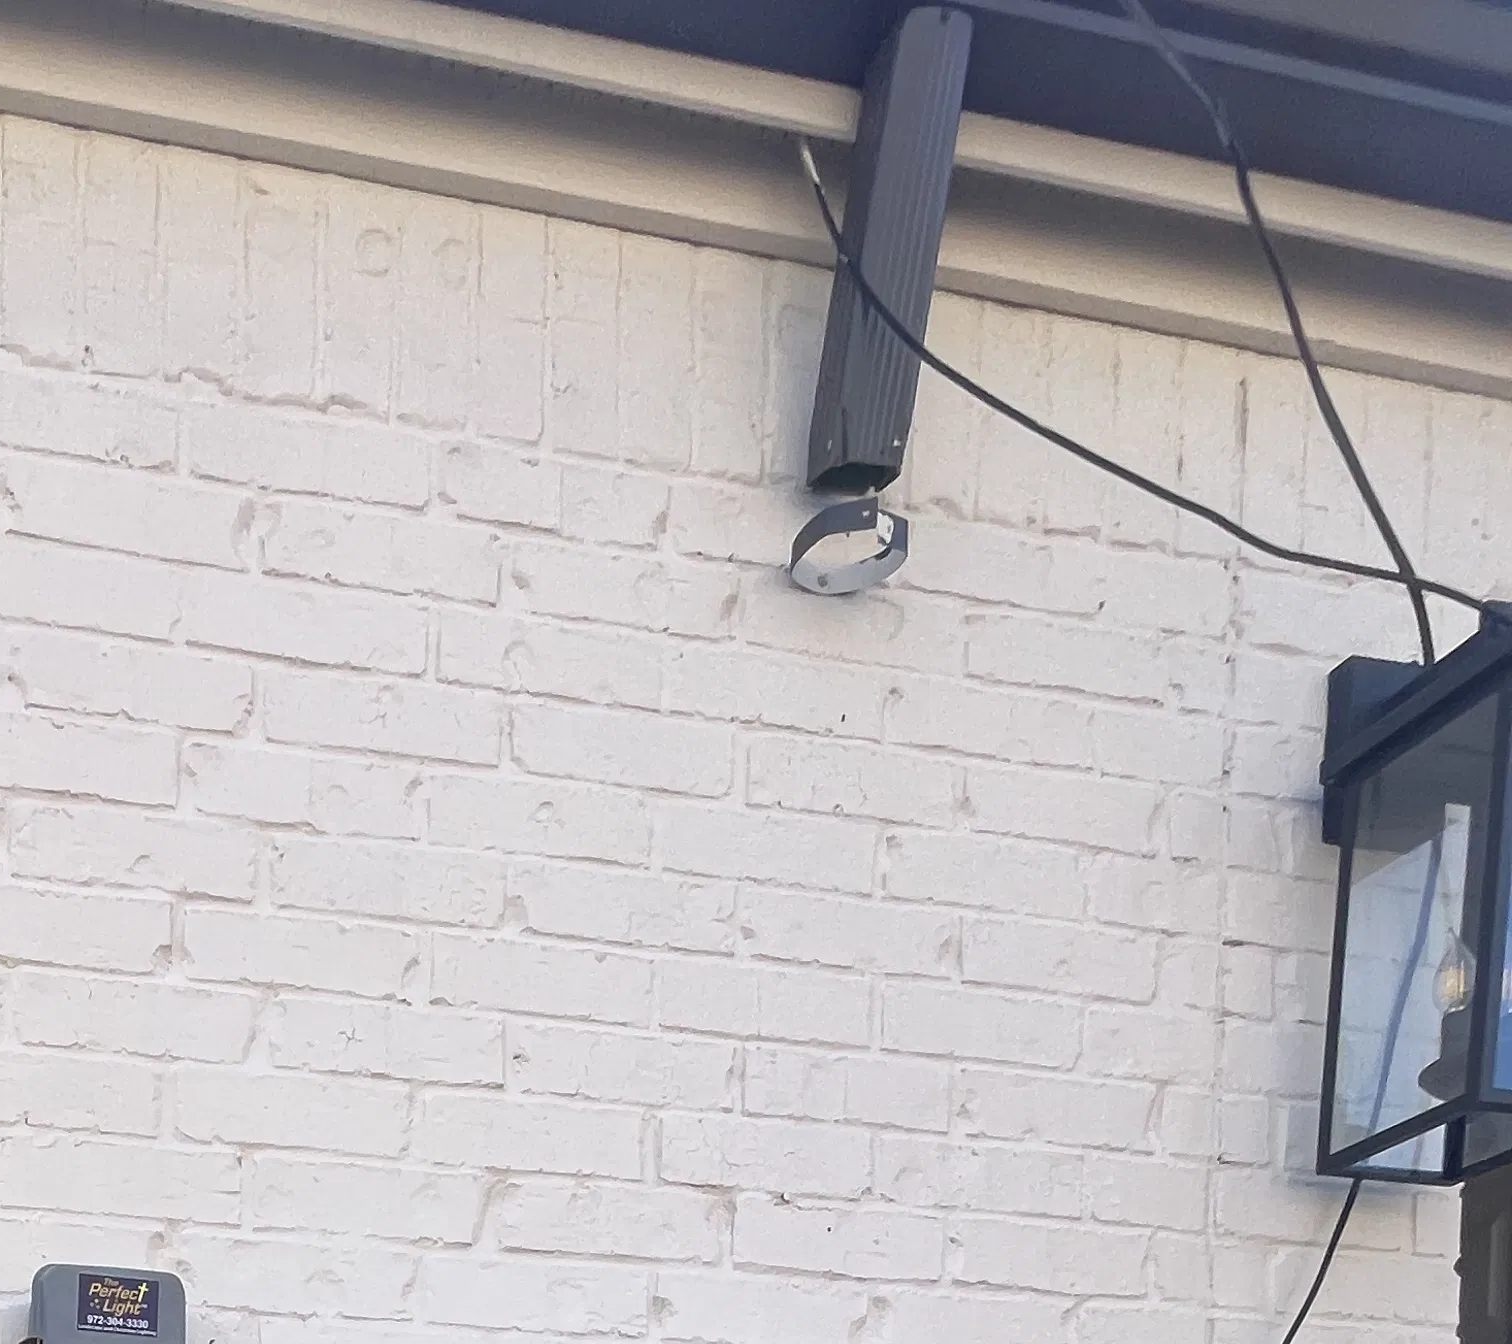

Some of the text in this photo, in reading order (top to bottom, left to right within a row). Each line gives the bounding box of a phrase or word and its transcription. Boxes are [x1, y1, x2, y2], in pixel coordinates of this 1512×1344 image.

[88, 1281, 149, 1303] Perfect
[102, 1298, 141, 1317] Light
[86, 1314, 149, 1329] 972-304-3330
